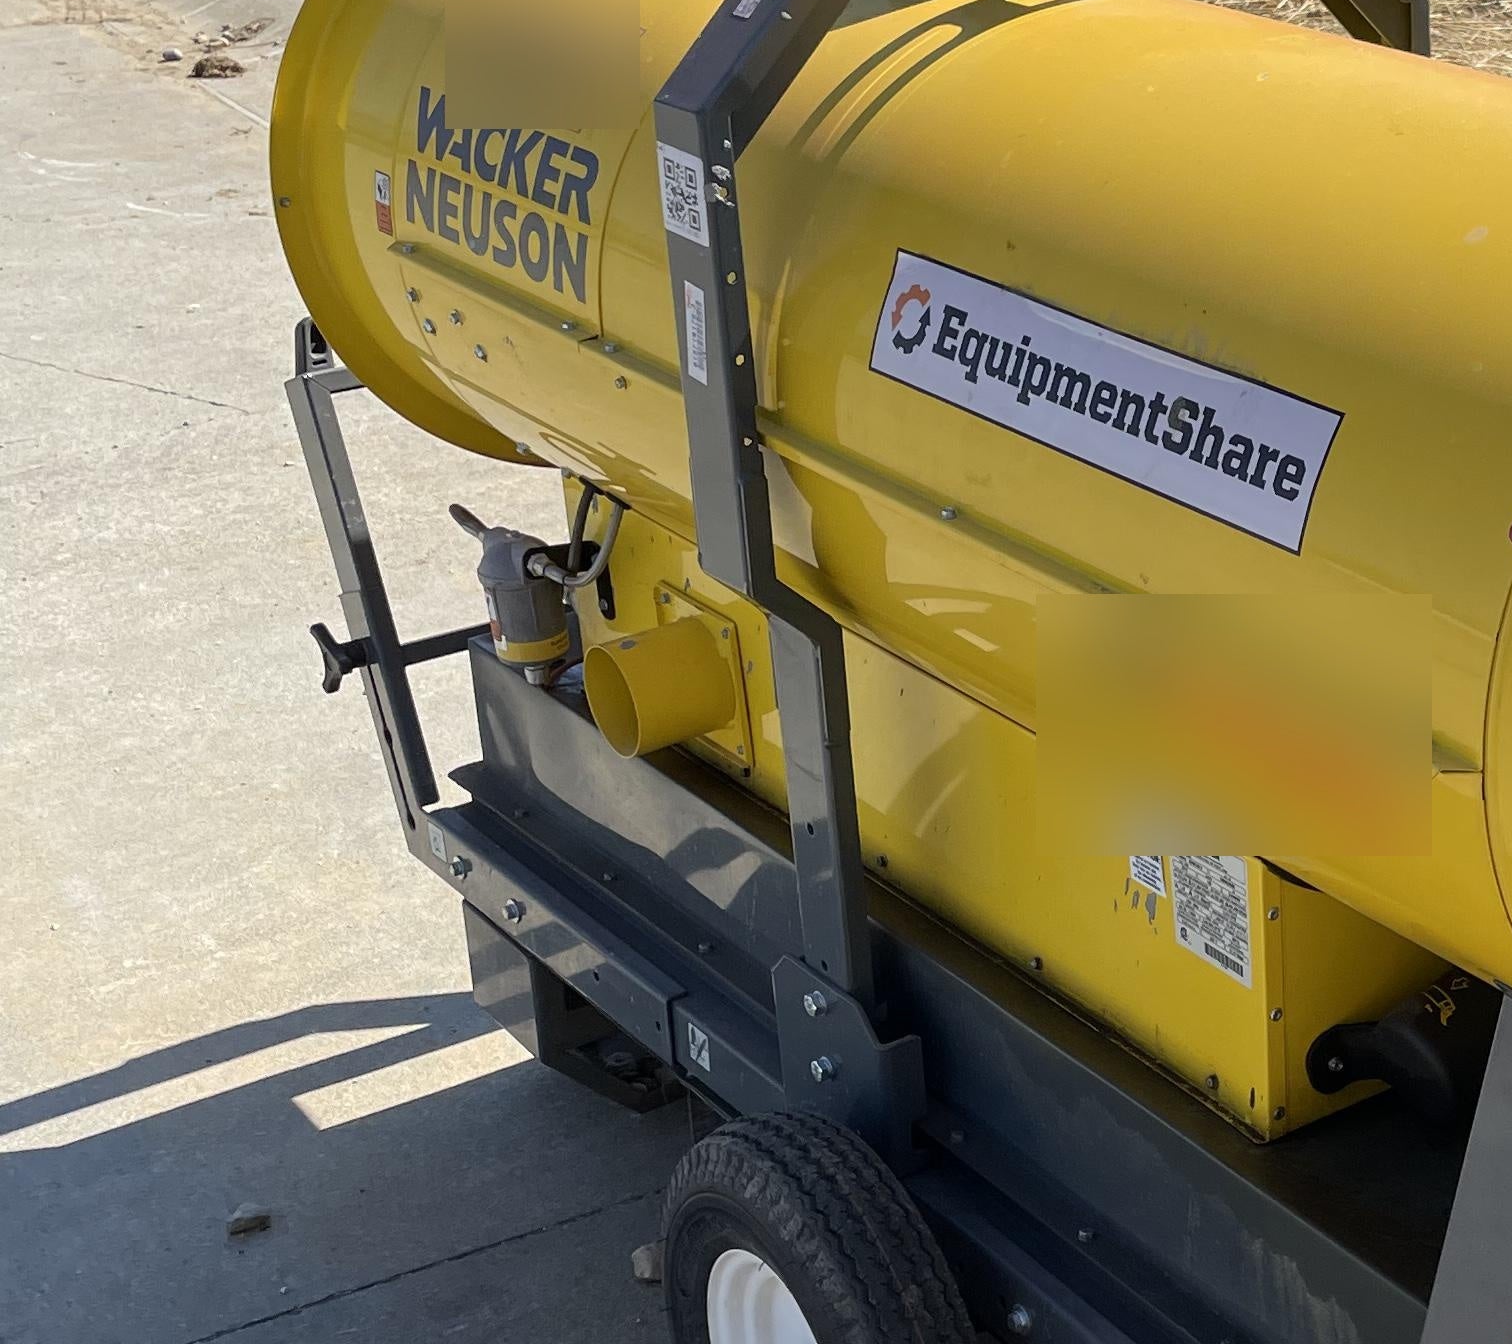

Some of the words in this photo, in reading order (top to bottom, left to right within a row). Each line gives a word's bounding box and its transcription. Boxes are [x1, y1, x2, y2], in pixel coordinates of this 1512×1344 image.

[417, 85, 599, 226] WACKER
[406, 158, 589, 305] NEUSON
[932, 304, 1307, 502] EquipmentShare
